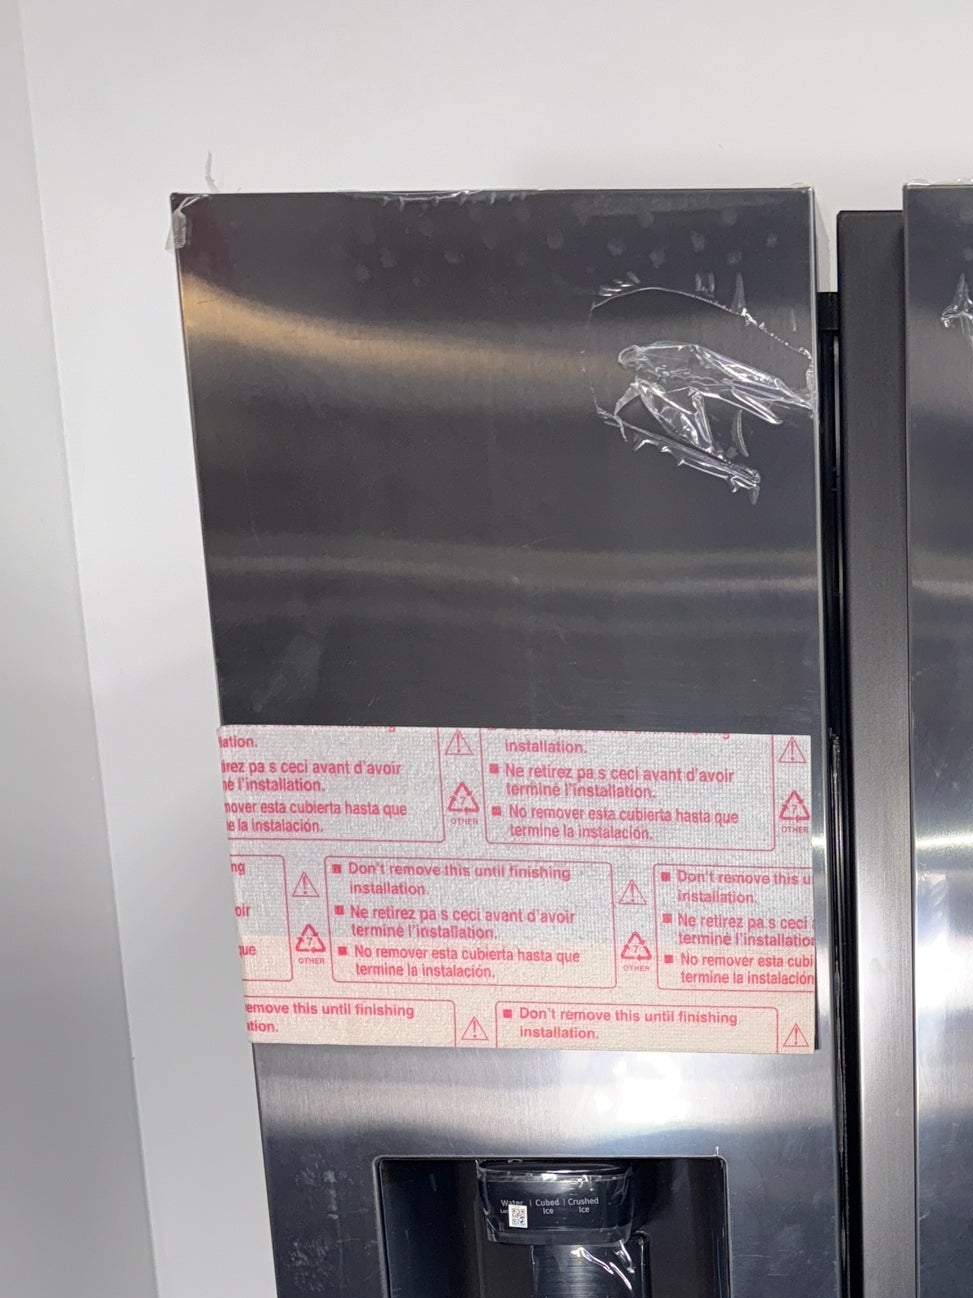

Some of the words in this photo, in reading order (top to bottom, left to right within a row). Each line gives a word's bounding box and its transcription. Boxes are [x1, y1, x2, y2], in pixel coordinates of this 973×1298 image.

[505, 739, 587, 754] installation.
[504, 763, 525, 778] Ne
[527, 764, 572, 780] retirez
[575, 767, 594, 784] pa
[597, 768, 606, 779] s
[609, 768, 639, 781] ceci
[642, 767, 683, 781] avant
[685, 768, 735, 783] d'avoir
[508, 804, 527, 818] No
[530, 807, 584, 820] remover
[588, 808, 615, 821] esta
[618, 808, 672, 822] cubierta
[675, 810, 711, 823] hasta
[714, 812, 739, 826] que
[509, 825, 559, 838] termine
[563, 827, 574, 838] la
[578, 826, 653, 840] instalación.
[348, 860, 385, 875] Don't
[388, 864, 440, 876] remove
[443, 864, 469, 876] this
[474, 865, 505, 877] until
[508, 864, 571, 882] finishing
[349, 882, 429, 895] installation.
[349, 905, 368, 920] Ne
[372, 906, 415, 921] retirez
[418, 908, 436, 924] pa
[440, 909, 448, 921] s
[452, 909, 481, 922] ceci
[485, 910, 523, 923] avant
[527, 909, 575, 923] d'avoir
[353, 944, 372, 958] No
[375, 947, 427, 959] remover
[430, 947, 458, 960] esta
[461, 947, 514, 961] cubierta
[517, 950, 552, 962] hasta
[555, 951, 580, 964] que
[355, 963, 404, 976] termine
[407, 965, 418, 976] la
[422, 965, 495, 978] instalación.
[518, 1005, 556, 1020] Don't
[560, 1010, 611, 1021] remove
[614, 1009, 639, 1022] this
[644, 1010, 675, 1022] until
[678, 1010, 738, 1026] finishing
[520, 1025, 599, 1039] installation.
[535, 1198, 560, 1207] Cubed
[567, 1197, 599, 1206] Crushed
[542, 1207, 554, 1215] Ice
